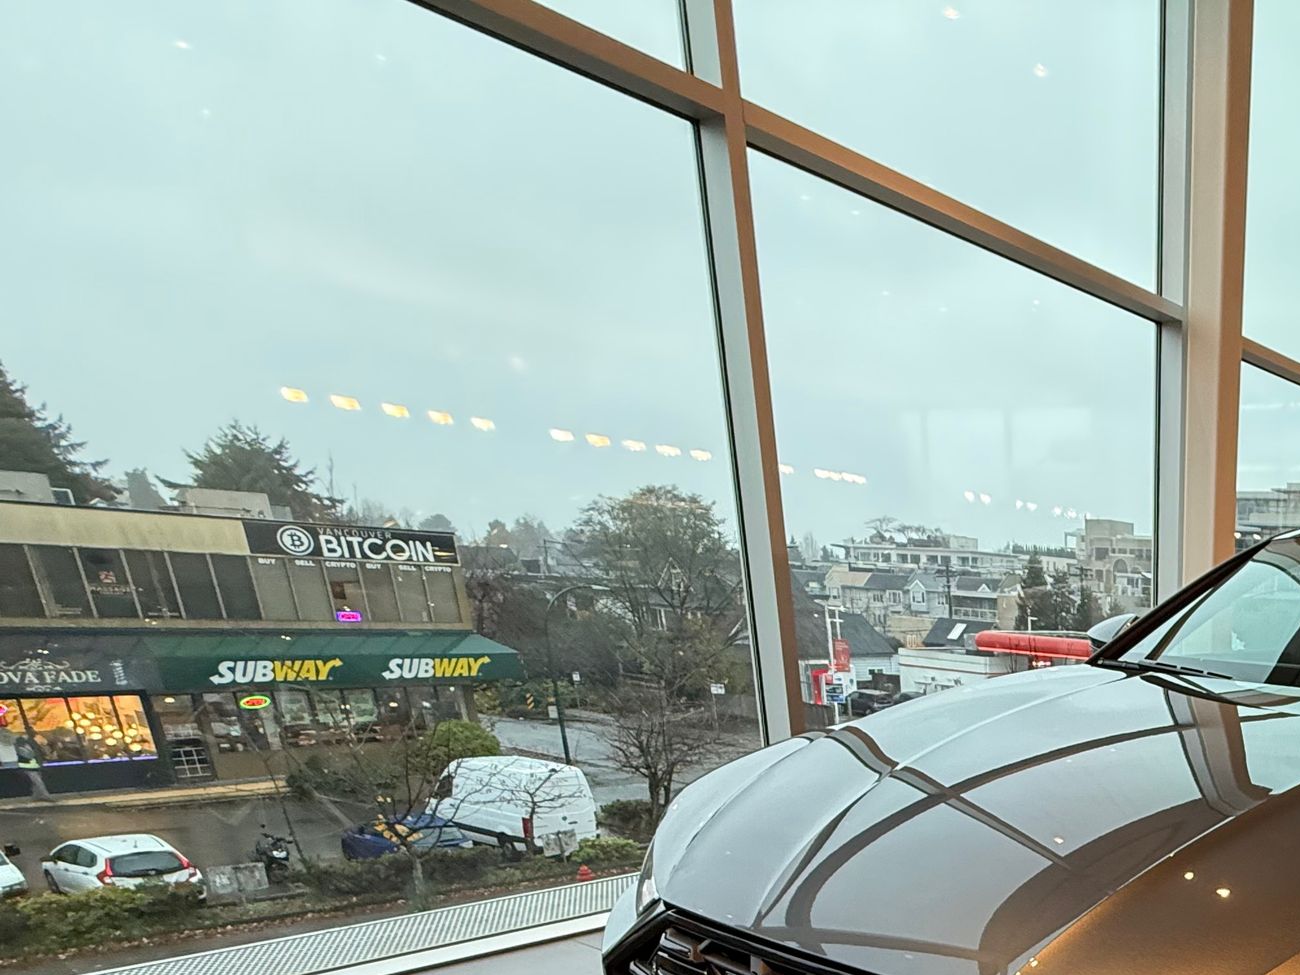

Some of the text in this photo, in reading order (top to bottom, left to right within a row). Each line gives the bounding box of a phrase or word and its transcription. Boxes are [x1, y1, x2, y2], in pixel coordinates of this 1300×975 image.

[317, 527, 392, 539] VANCOUVER
[318, 534, 435, 562] BITCOIN
[294, 559, 315, 567] SELL
[325, 560, 356, 568] CRYPTO
[424, 565, 452, 573] CRYPTO
[44, 670, 102, 684] FADE
[209, 657, 343, 685] SUBWAY
[381, 655, 491, 680] SUBWAY
